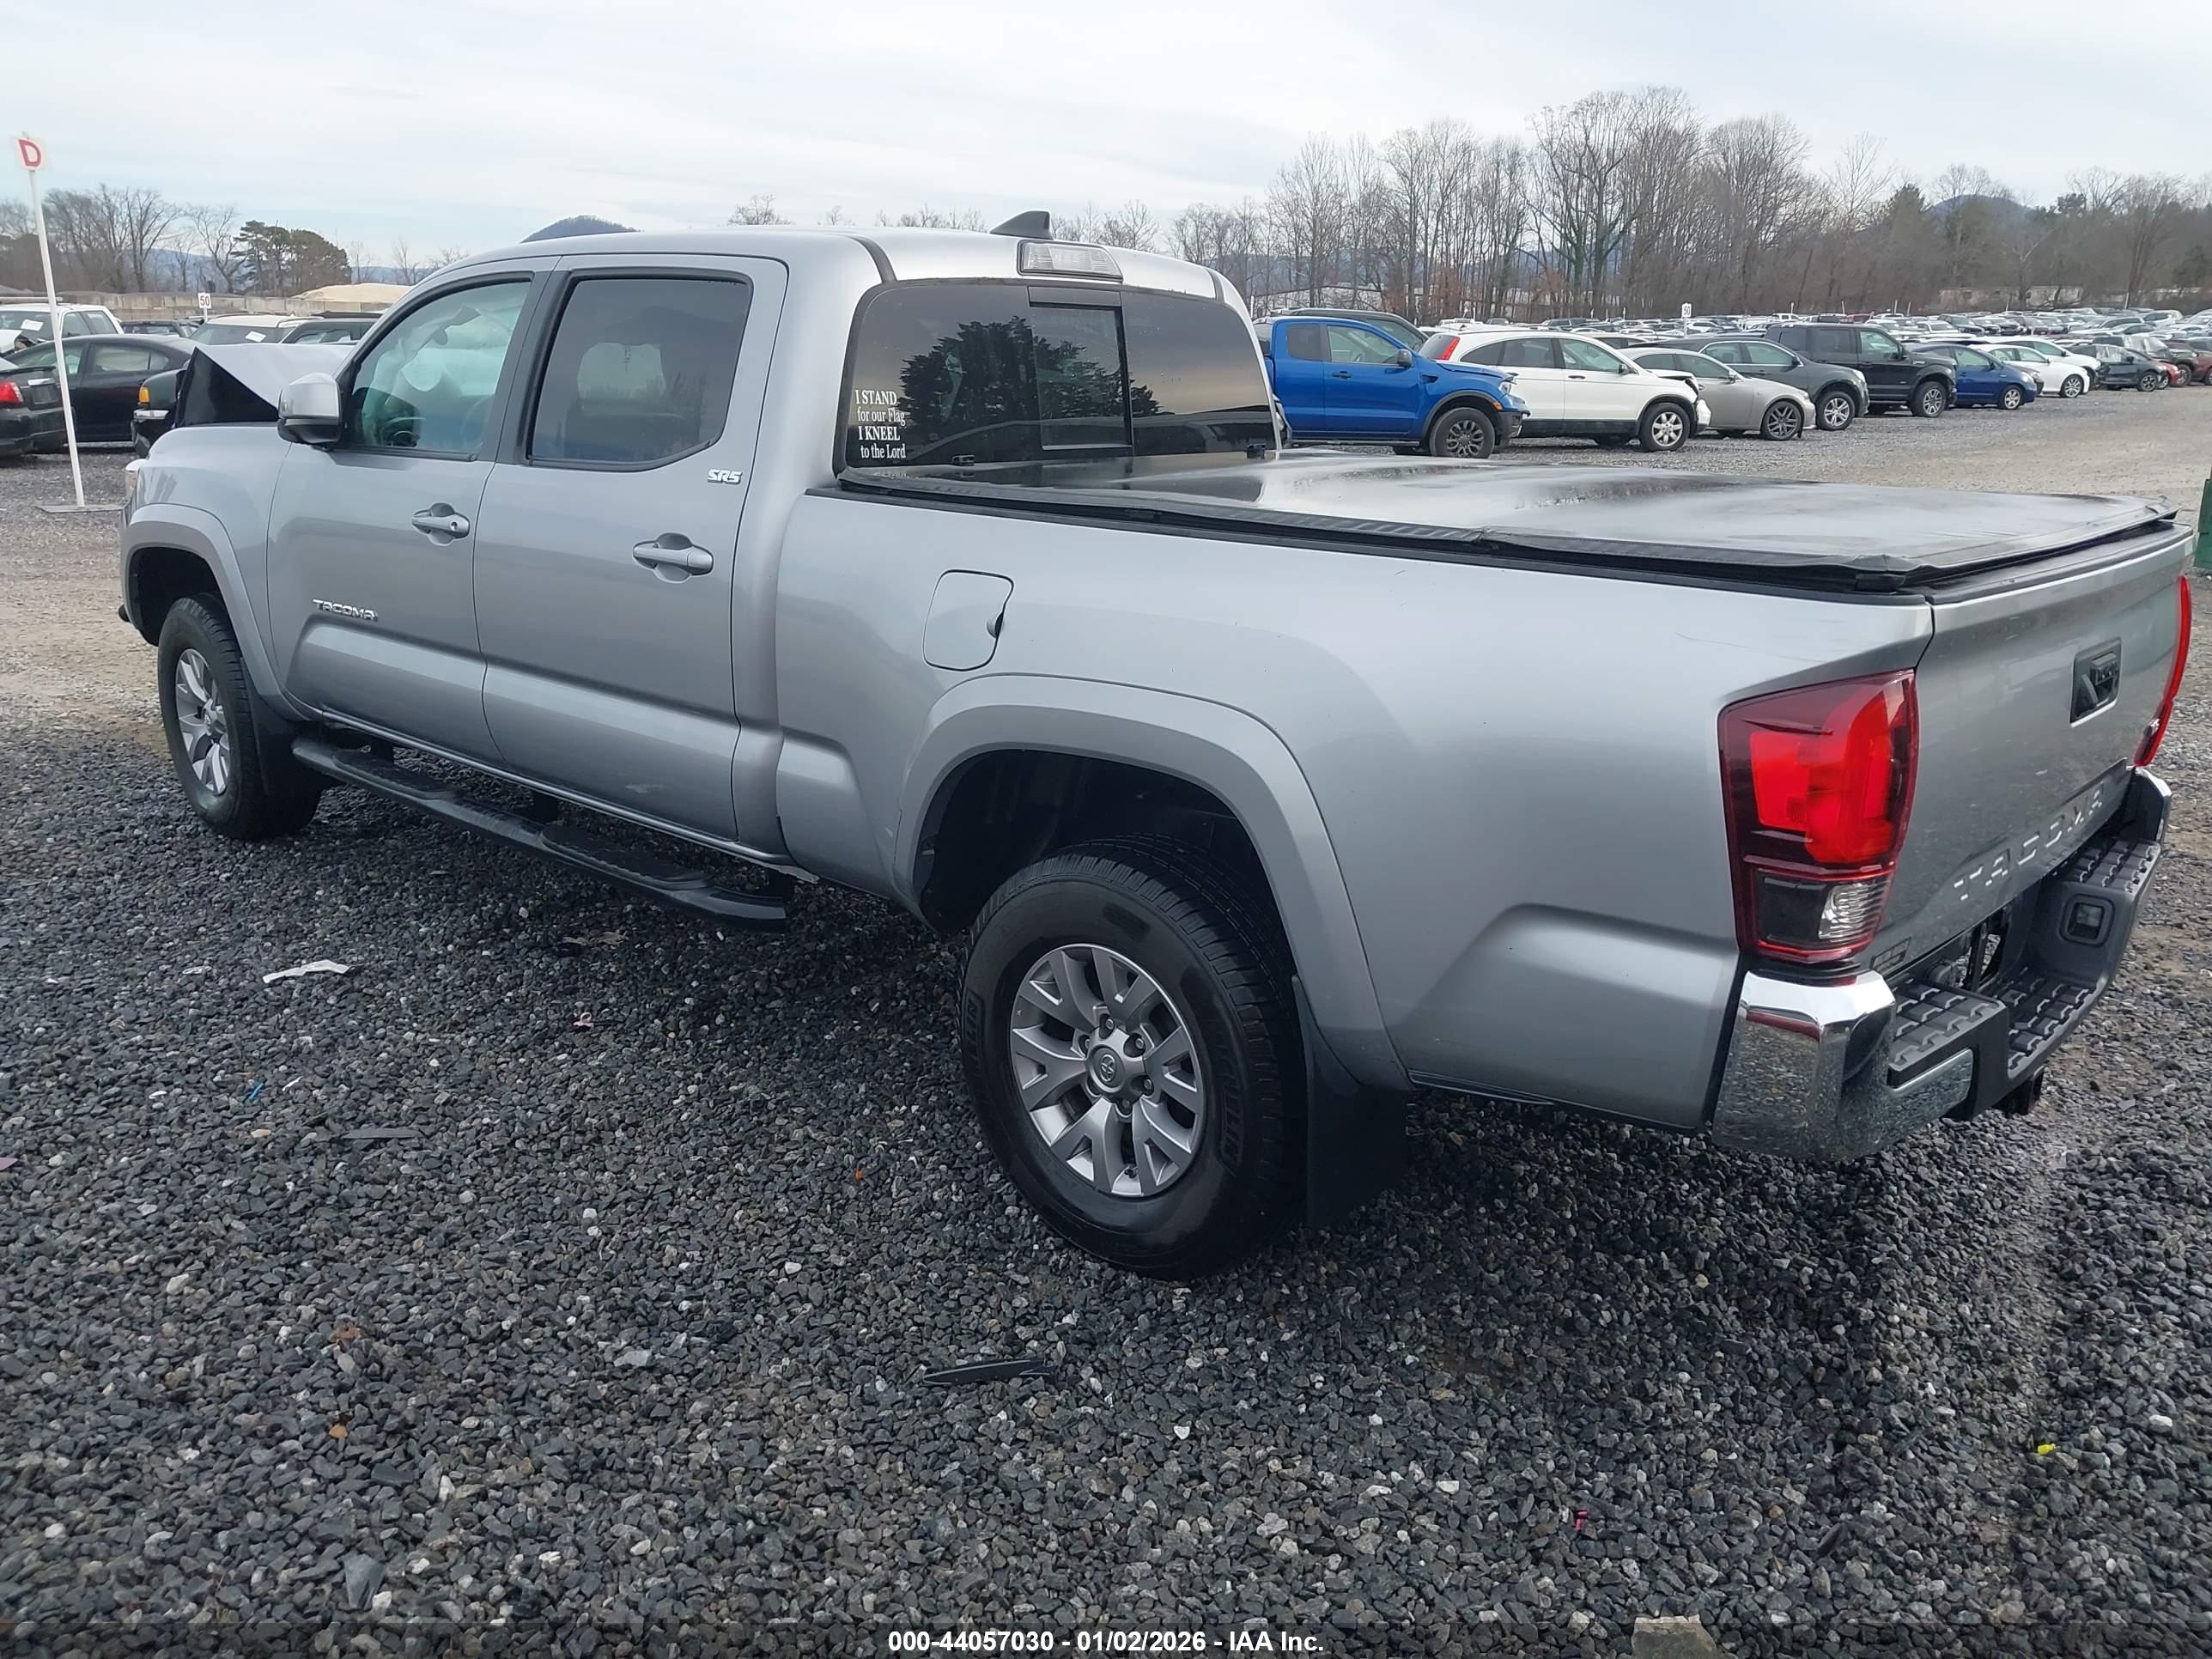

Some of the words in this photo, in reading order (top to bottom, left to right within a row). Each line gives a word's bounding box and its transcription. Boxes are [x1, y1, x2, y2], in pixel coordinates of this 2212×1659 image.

[19, 139, 41, 167] D
[199, 295, 210, 307] 50
[855, 390, 860, 404] I
[861, 390, 897, 405] STAND
[857, 406, 870, 422] for
[872, 410, 886, 422] our
[888, 407, 906, 427] Flag
[859, 426, 864, 440] I
[865, 426, 900, 441] KNEEL
[860, 445, 870, 459] to
[871, 443, 885, 459] the
[886, 443, 906, 459] Lord
[313, 599, 378, 620] TACOMA
[1953, 787, 2104, 902] TACOMA
